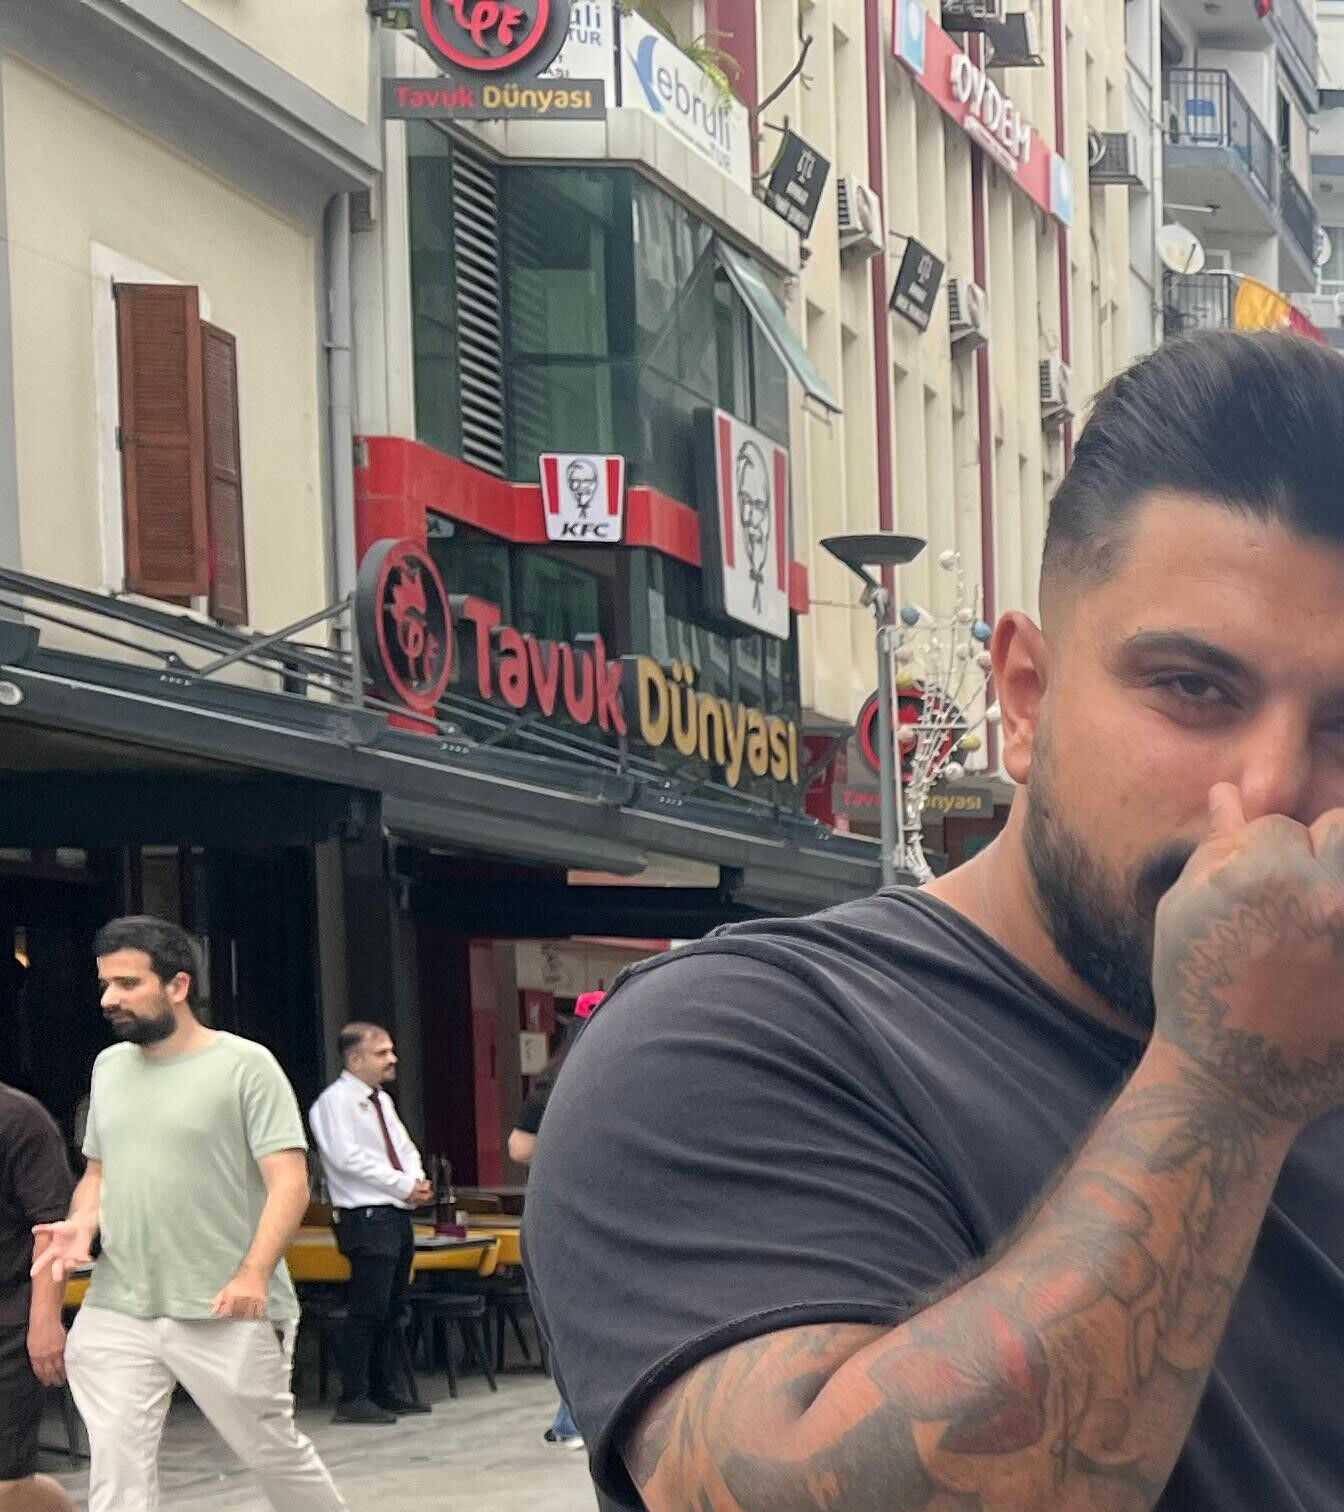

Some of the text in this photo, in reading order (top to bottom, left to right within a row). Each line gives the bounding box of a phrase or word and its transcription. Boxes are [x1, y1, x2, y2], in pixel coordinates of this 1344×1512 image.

[395, 84, 592, 113] Tavuk Dünyası
[657, 67, 731, 151] ebruli
[561, 521, 609, 538] KFC
[465, 596, 799, 788] Tavuk Dünyası
